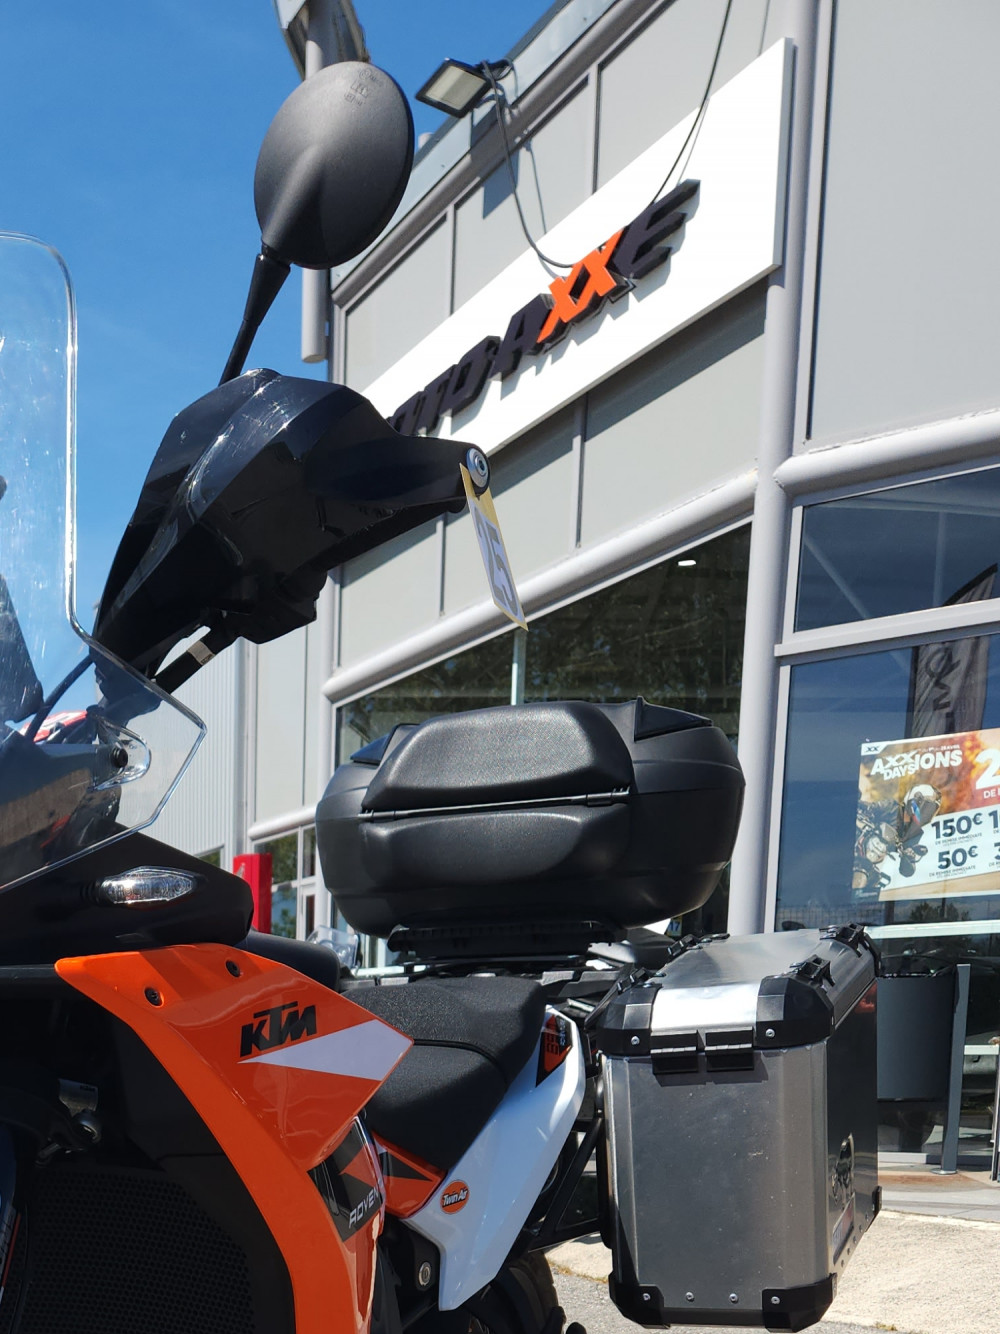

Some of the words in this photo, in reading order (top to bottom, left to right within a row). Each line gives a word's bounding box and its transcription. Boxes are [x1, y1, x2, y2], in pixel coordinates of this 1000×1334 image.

[870, 749, 963, 775] AXXIONS
[883, 763, 917, 780] DAYS
[931, 812, 983, 840] 150€
[988, 809, 1000, 829] 1
[937, 845, 979, 870] 50€
[240, 1000, 318, 1058] KTM
